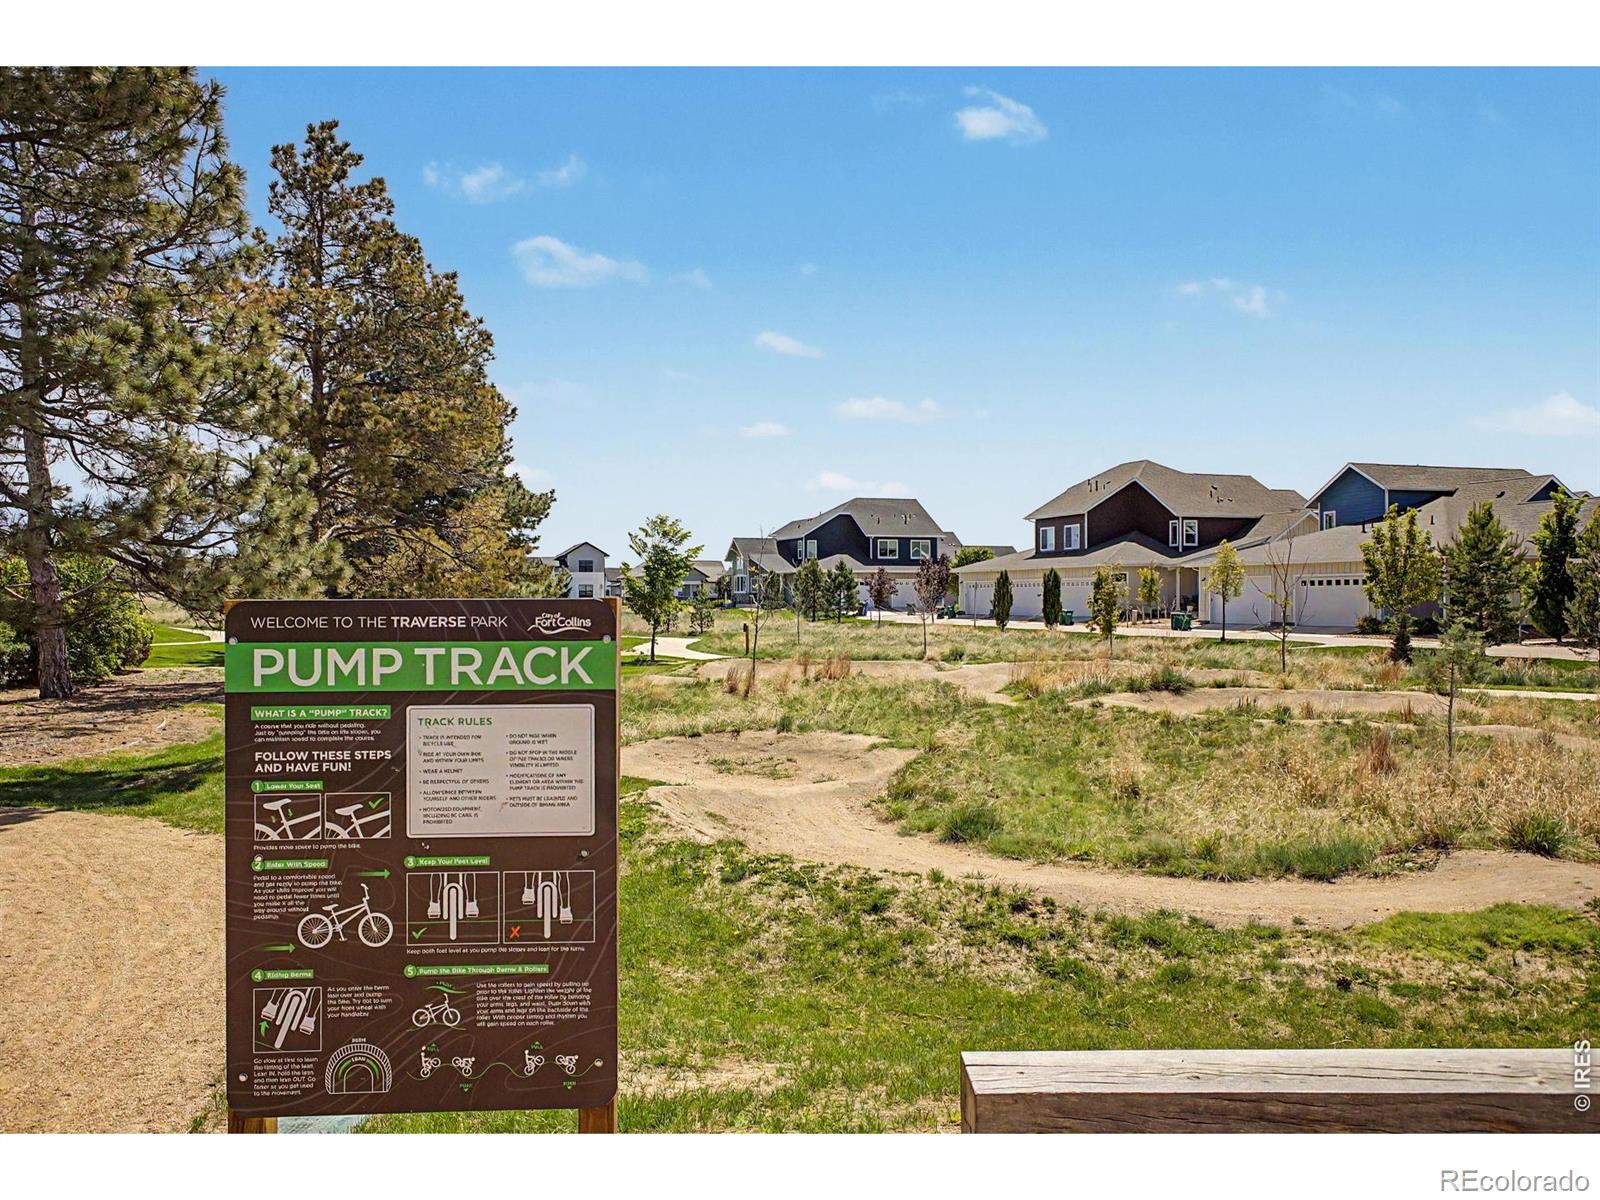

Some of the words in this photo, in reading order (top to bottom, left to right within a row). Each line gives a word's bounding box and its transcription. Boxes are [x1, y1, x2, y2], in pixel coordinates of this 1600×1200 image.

[541, 612, 554, 620] City
[250, 616, 329, 629] WELCOME
[332, 616, 353, 628] TO
[356, 616, 387, 628] THE
[390, 616, 467, 628] TRAVERSE
[470, 616, 508, 628] PARK
[535, 616, 557, 627] Fort
[557, 616, 592, 627] Collins
[253, 648, 403, 687] PUMP
[415, 646, 594, 686] TRACK
[255, 710, 285, 718] WHAT
[287, 709, 297, 717] IS
[299, 709, 307, 717] A
[308, 709, 347, 717] "PUMP"
[349, 708, 387, 717] TRACK?
[417, 717, 455, 726] TRACK
[457, 717, 493, 726] RULES
[255, 751, 309, 762] FOLLOW
[311, 750, 352, 761] THESE
[354, 750, 392, 760] STEPS
[255, 762, 283, 773] AND
[285, 762, 320, 773] HAVE
[322, 761, 352, 772] FUN!
[255, 782, 260, 791] 1
[407, 858, 414, 866] 3
[254, 971, 261, 979] 4
[407, 966, 414, 976] 5
